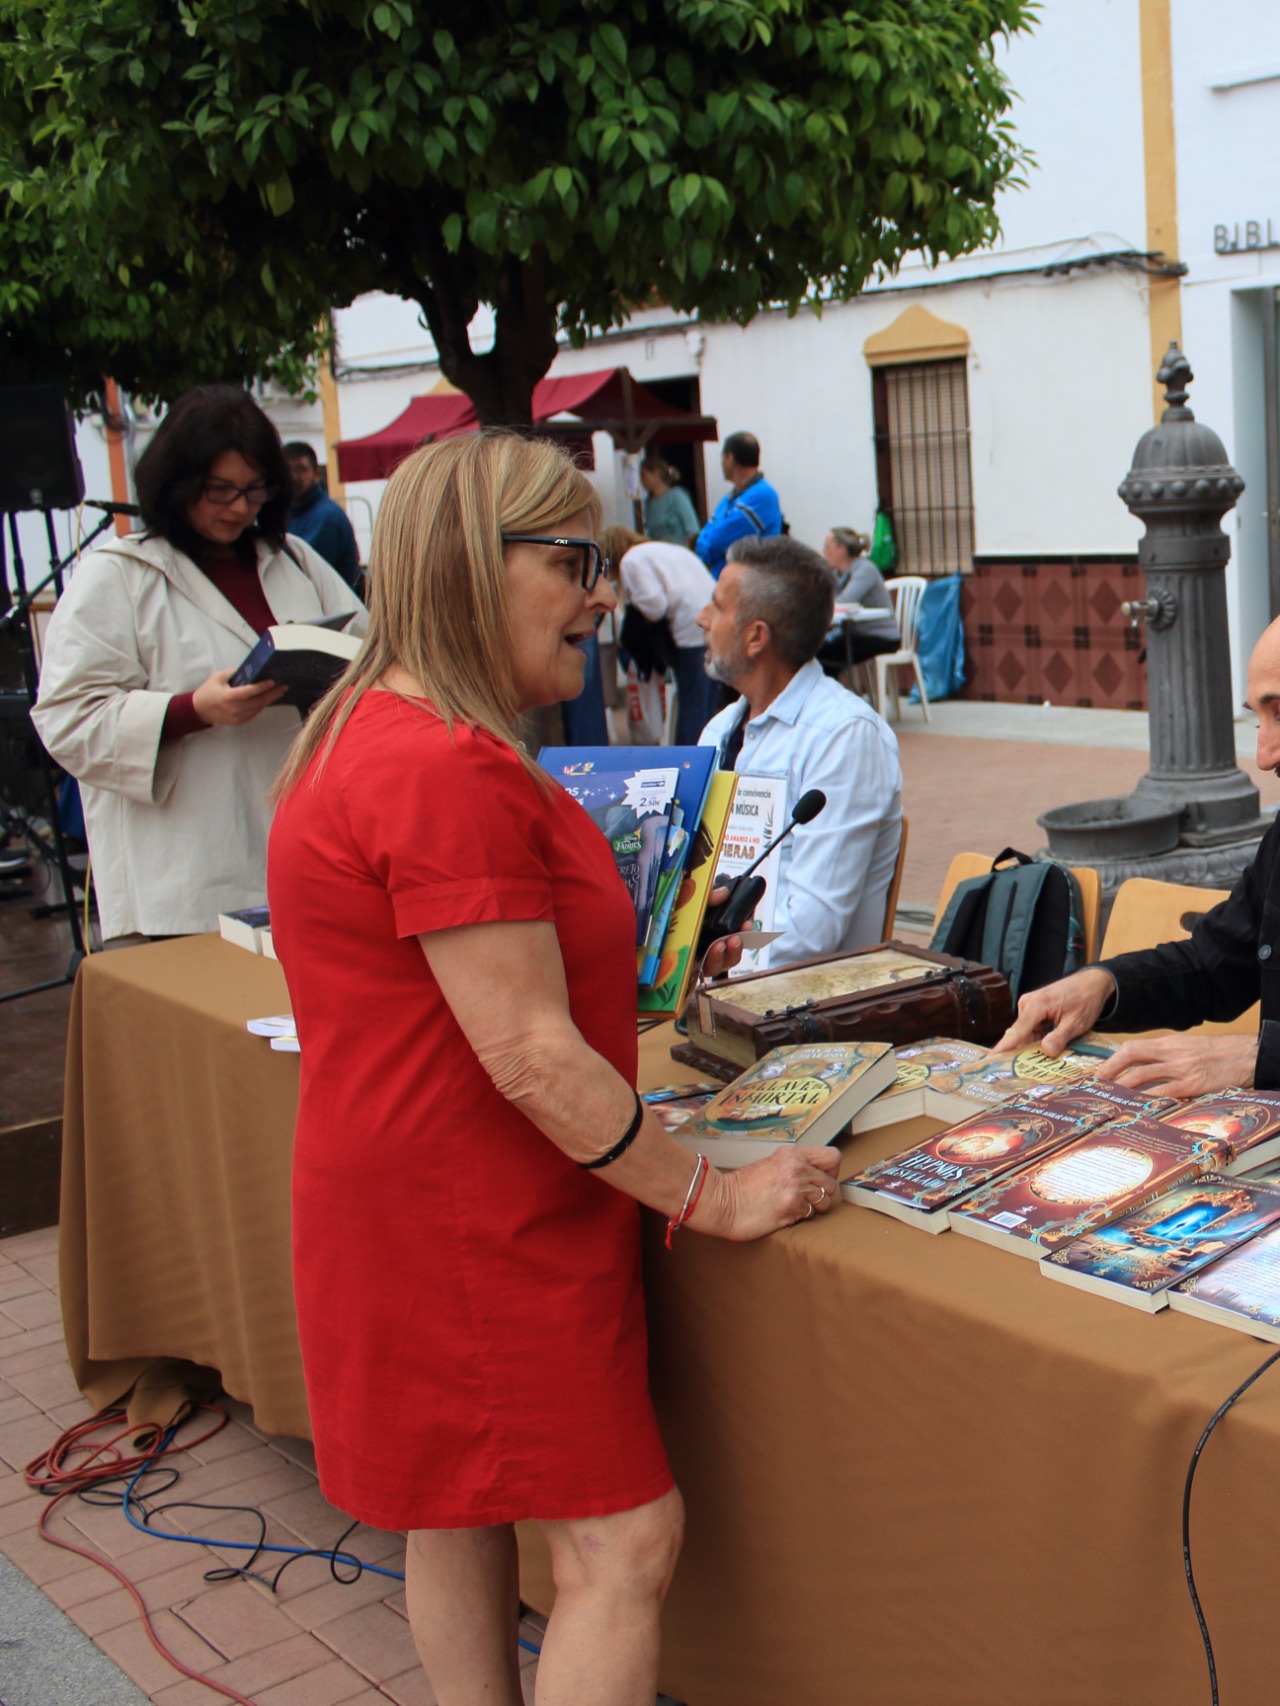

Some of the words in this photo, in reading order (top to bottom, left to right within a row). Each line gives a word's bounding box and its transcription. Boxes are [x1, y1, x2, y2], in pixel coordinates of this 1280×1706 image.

[743, 788, 771, 798] convivencia
[735, 800, 759, 816] MÚSICA
[616, 840, 642, 851] FAIRIES
[719, 1091, 820, 1106] INMORTAL
[898, 1153, 973, 1181] HYPNOS
